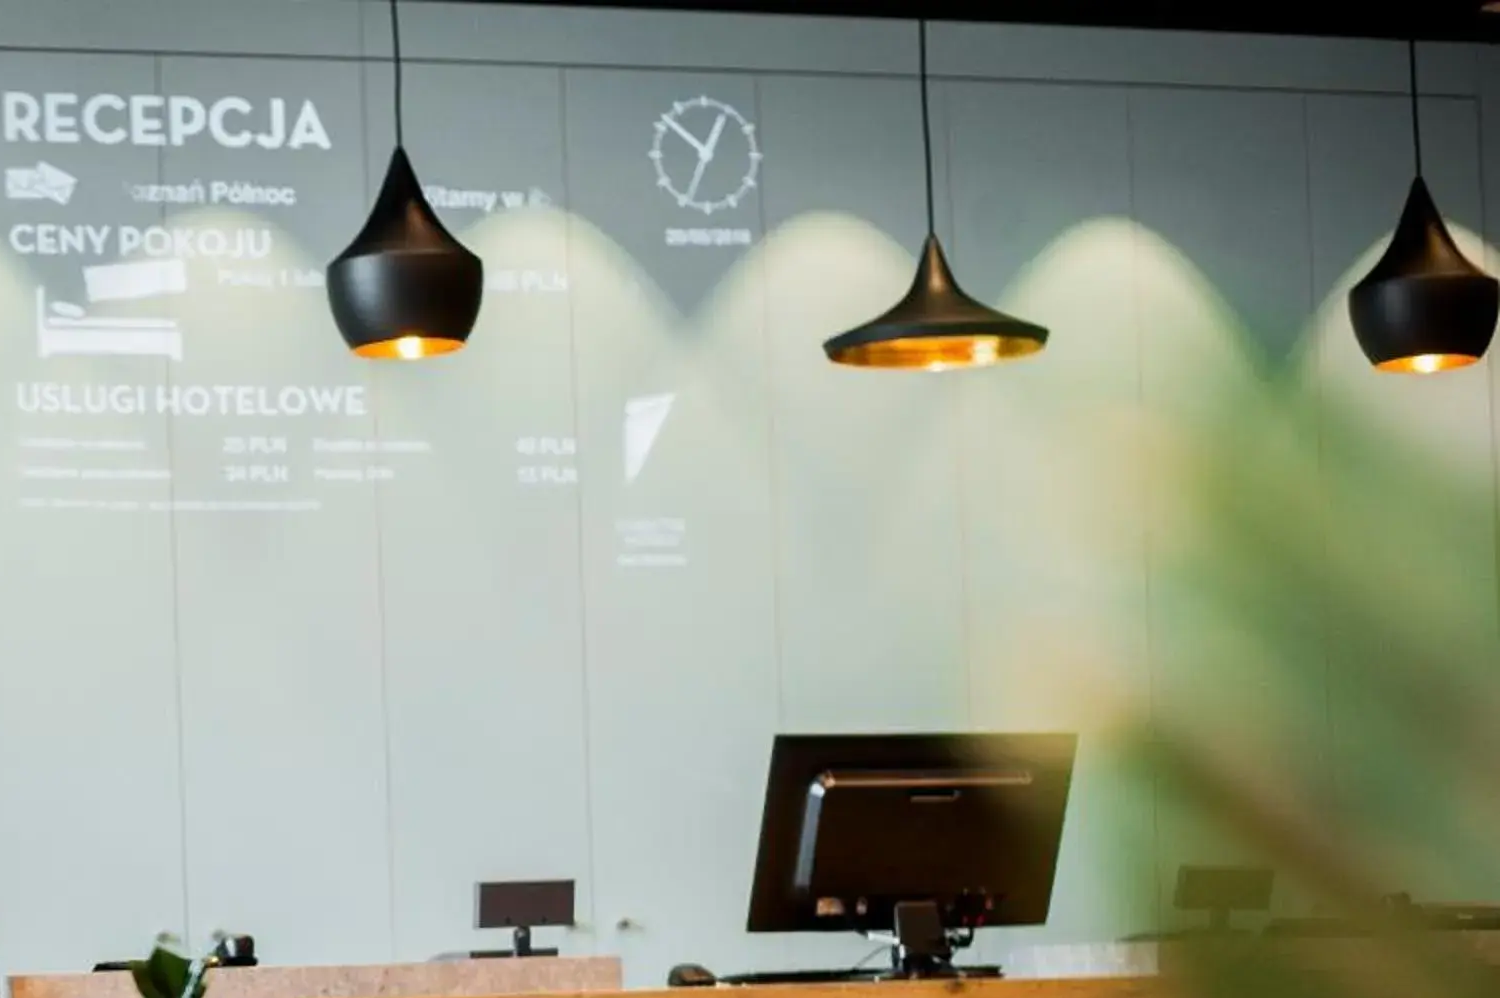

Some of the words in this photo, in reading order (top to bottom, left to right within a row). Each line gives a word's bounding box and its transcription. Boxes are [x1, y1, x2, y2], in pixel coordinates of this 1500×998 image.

[2, 91, 332, 150] RECEPCJA
[9, 223, 111, 256] CENY
[118, 225, 273, 259] POKOJU
[155, 385, 368, 417] HOTELOWE
